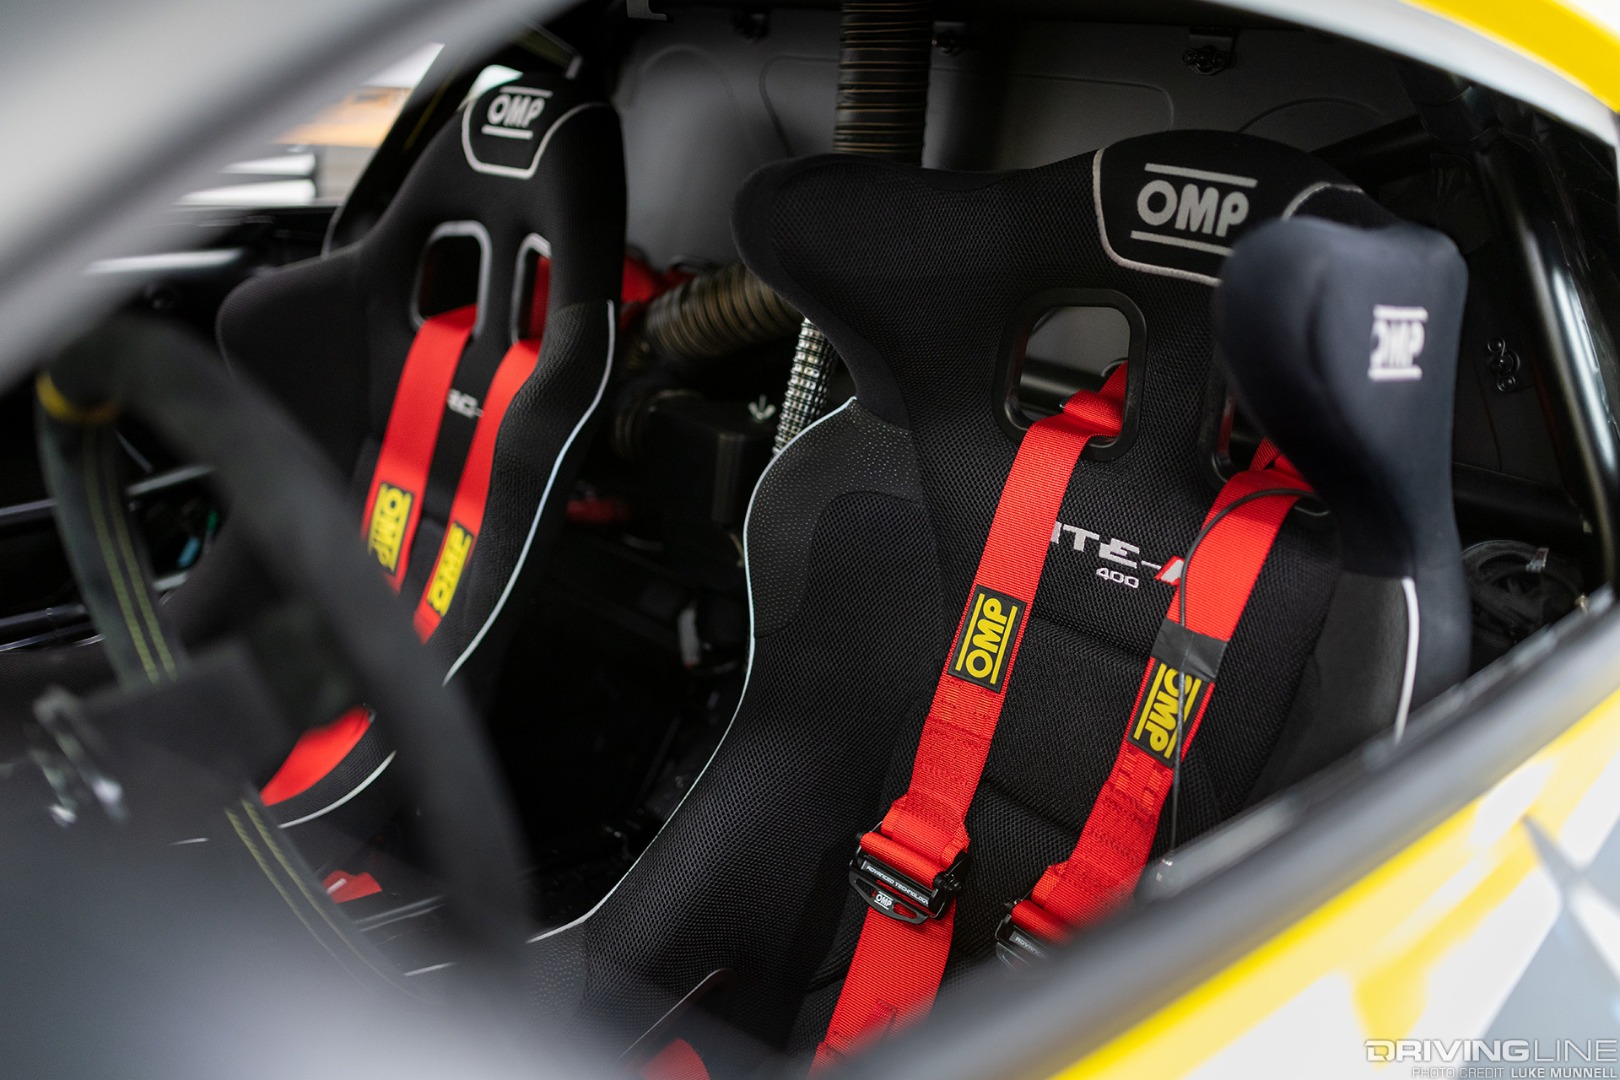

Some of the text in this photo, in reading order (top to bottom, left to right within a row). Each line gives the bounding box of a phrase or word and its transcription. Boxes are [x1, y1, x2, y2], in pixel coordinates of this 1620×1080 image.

[487, 93, 545, 128] OMP
[1137, 179, 1249, 237] OMP
[371, 486, 405, 569] OMP
[1096, 567, 1140, 588] 400
[965, 597, 1008, 679] OMP
[1144, 667, 1193, 752] OMP
[875, 893, 893, 907] OMP
